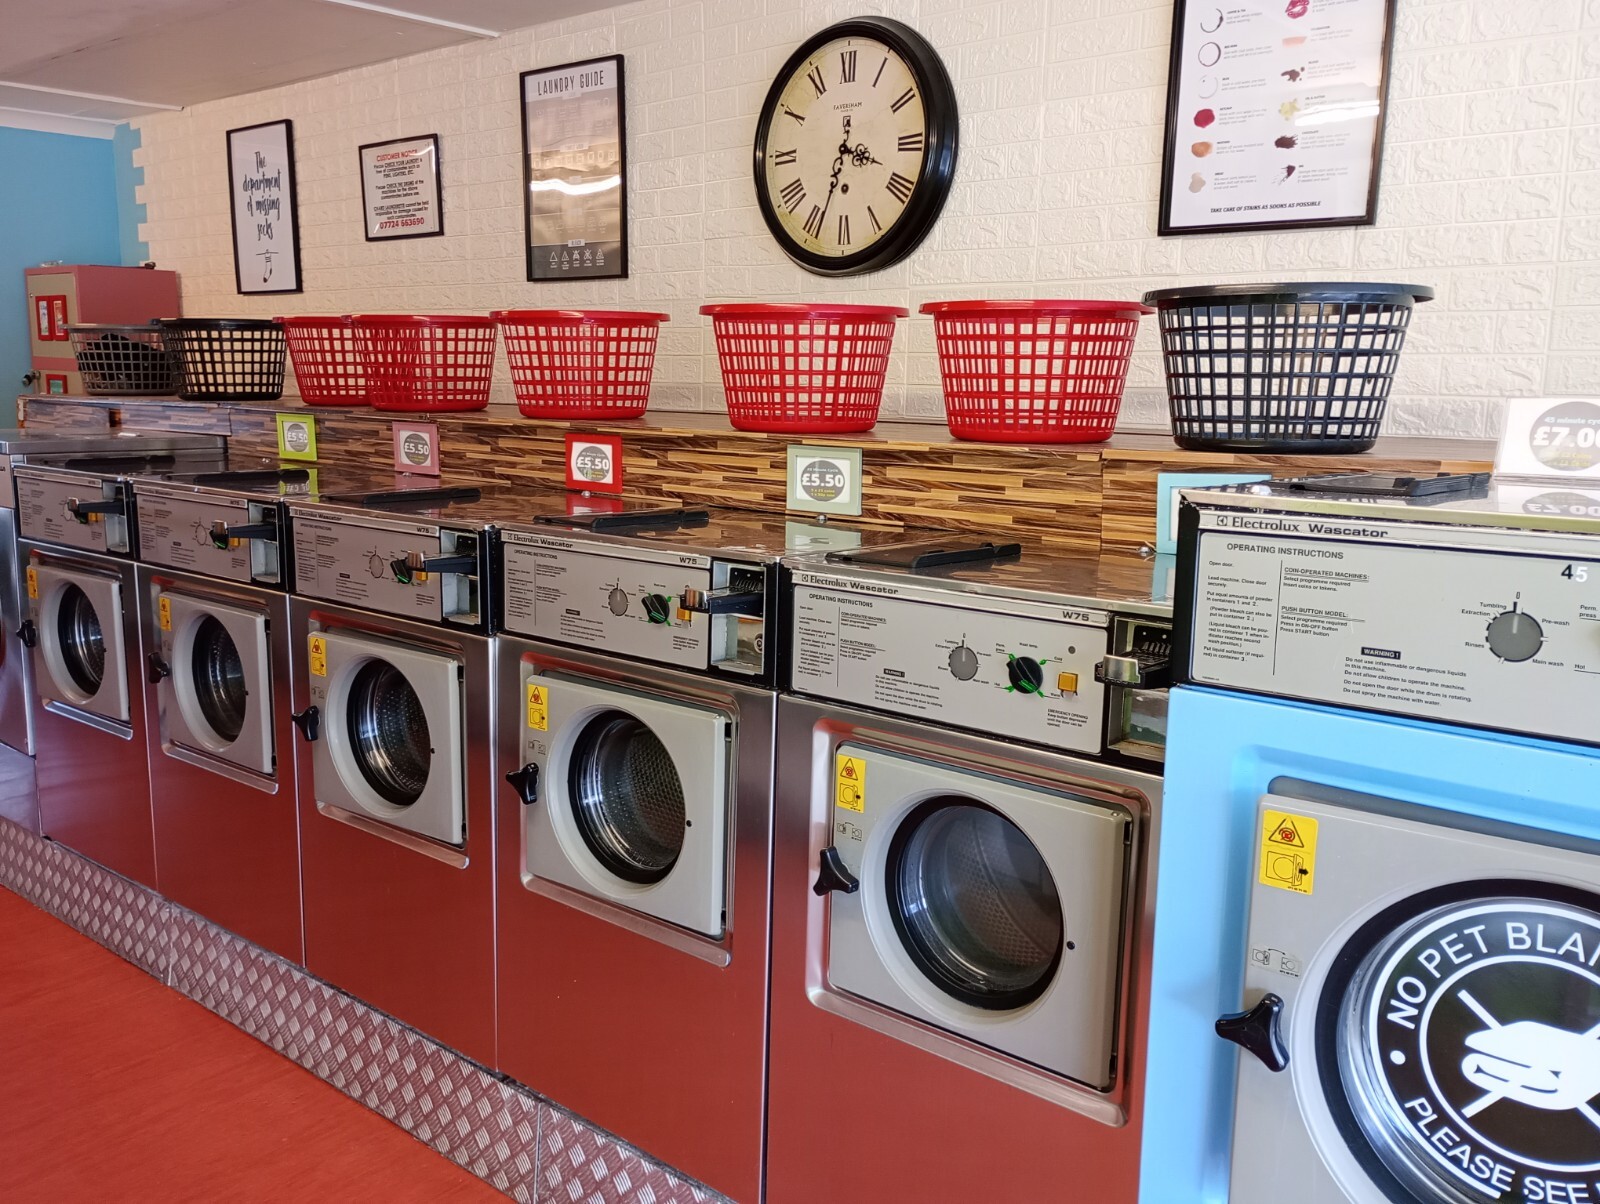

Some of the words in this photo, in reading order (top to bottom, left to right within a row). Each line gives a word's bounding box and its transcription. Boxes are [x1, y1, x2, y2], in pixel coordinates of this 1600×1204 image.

[538, 76, 575, 96] LAUNDRY
[580, 70, 604, 89] GUIDE
[834, 102, 862, 110] FAVERSHAM
[255, 152, 267, 174] The
[377, 152, 400, 162] CUSTOMER
[243, 169, 281, 196] department
[247, 195, 254, 216] of
[256, 194, 280, 221] missing
[257, 217, 273, 241] socks
[380, 220, 399, 229] 07724
[405, 443, 429, 454] £5.50
[577, 457, 609, 470] £5.50
[802, 473, 844, 487] £5.50
[1232, 517, 1300, 532] Electrolux
[1308, 523, 1388, 538] Wascator
[514, 534, 539, 544] Electrolux
[540, 539, 573, 548] Wascator
[680, 557, 697, 565] W75
[533, 551, 557, 559] INSTRUCTIONS
[1227, 543, 1275, 554] OPERATING
[1278, 547, 1344, 560] INSTRUCTIONS
[1284, 567, 1334, 576] COIN-OPERATED
[1334, 570, 1370, 580] MACHINES:
[1561, 564, 1588, 582] 45
[809, 593, 836, 602] OPERATING
[837, 598, 873, 608] INSTRUCTIONS
[810, 576, 847, 588] Electrolux
[850, 582, 898, 595] Wascator
[1062, 611, 1090, 621] W75
[1480, 602, 1507, 610] Tumbling
[1325, 609, 1348, 618] MODEL:
[1542, 618, 1570, 626] Pre-wash
[1364, 648, 1395, 658] WARNING
[1375, 660, 1408, 669] inflammable
[1416, 666, 1446, 674] dangerous
[1448, 694, 1472, 702] rotating.
[1387, 976, 1427, 1030] NO
[1418, 924, 1488, 979] PET
[1404, 1097, 1515, 1192] PLEASE
[1523, 1177, 1590, 1204] SEE
